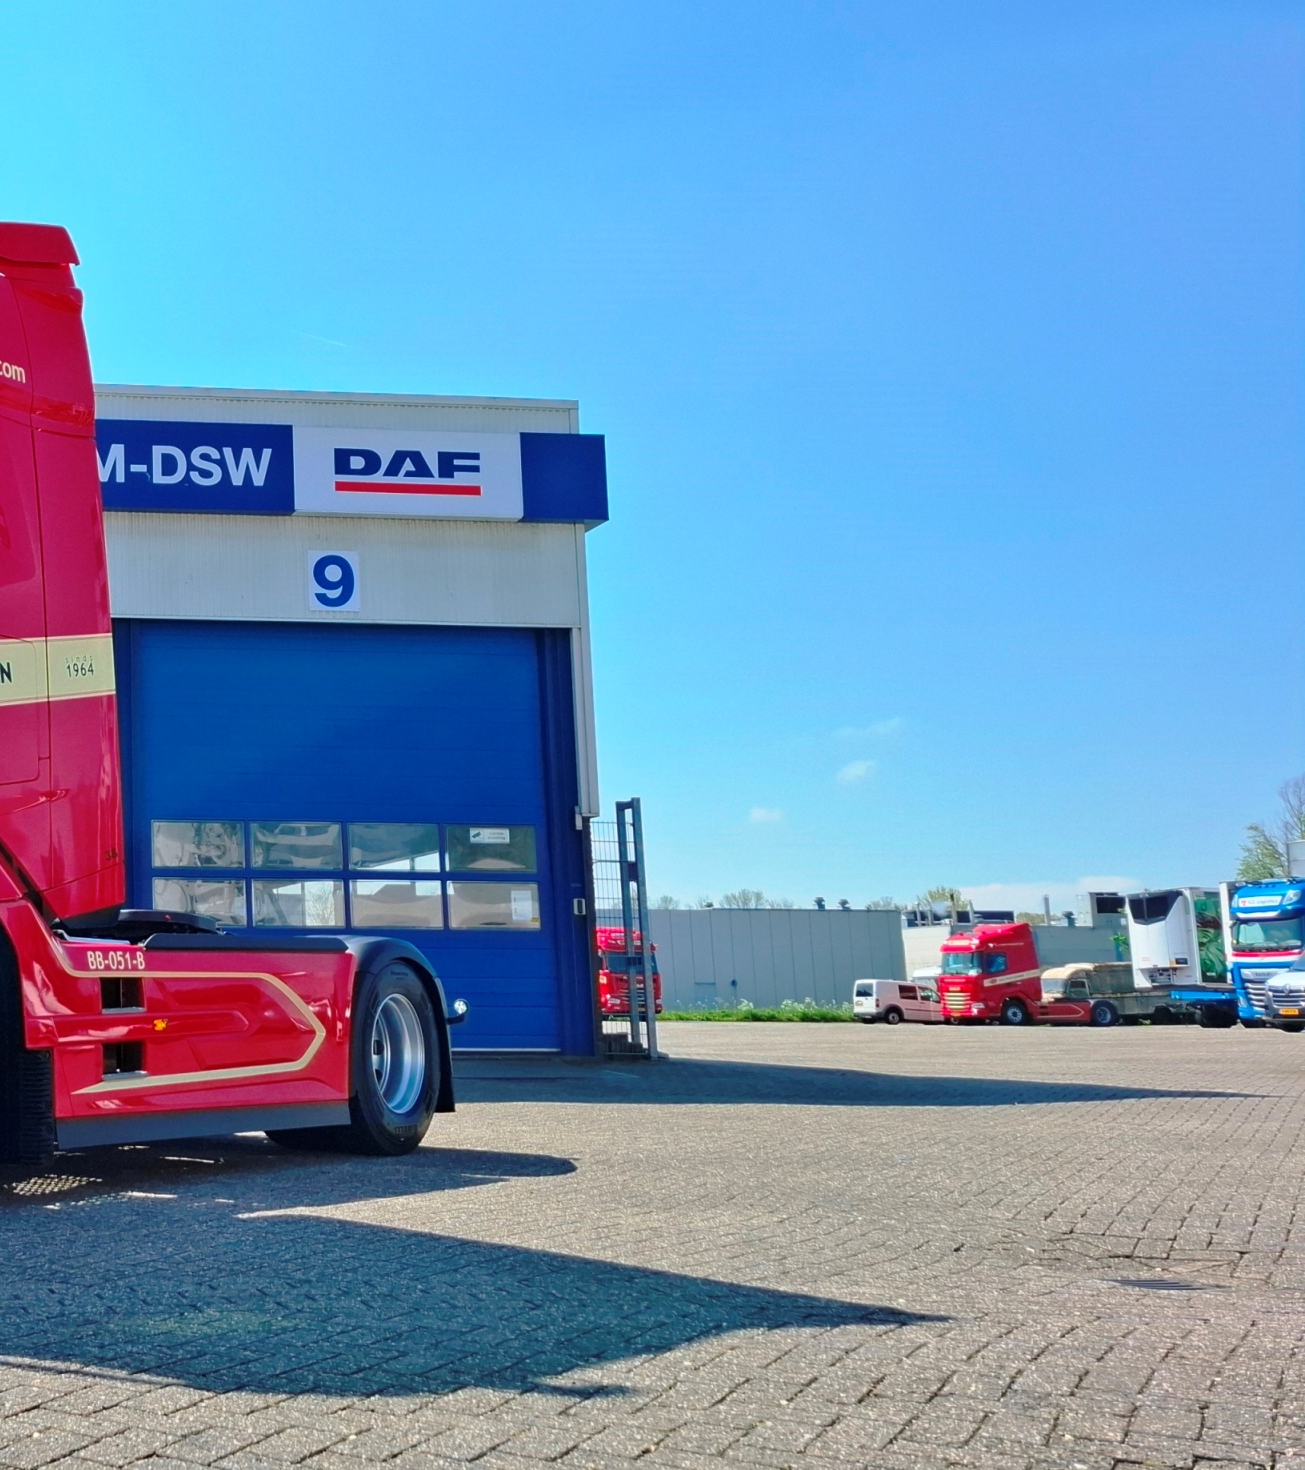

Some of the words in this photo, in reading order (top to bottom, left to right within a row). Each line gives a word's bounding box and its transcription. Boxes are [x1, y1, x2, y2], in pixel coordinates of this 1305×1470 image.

[96, 443, 273, 486] M-DSW
[333, 448, 481, 478] DAF
[313, 554, 355, 608] 9
[66, 662, 94, 678] 1964
[86, 950, 146, 970] BB-051-B
